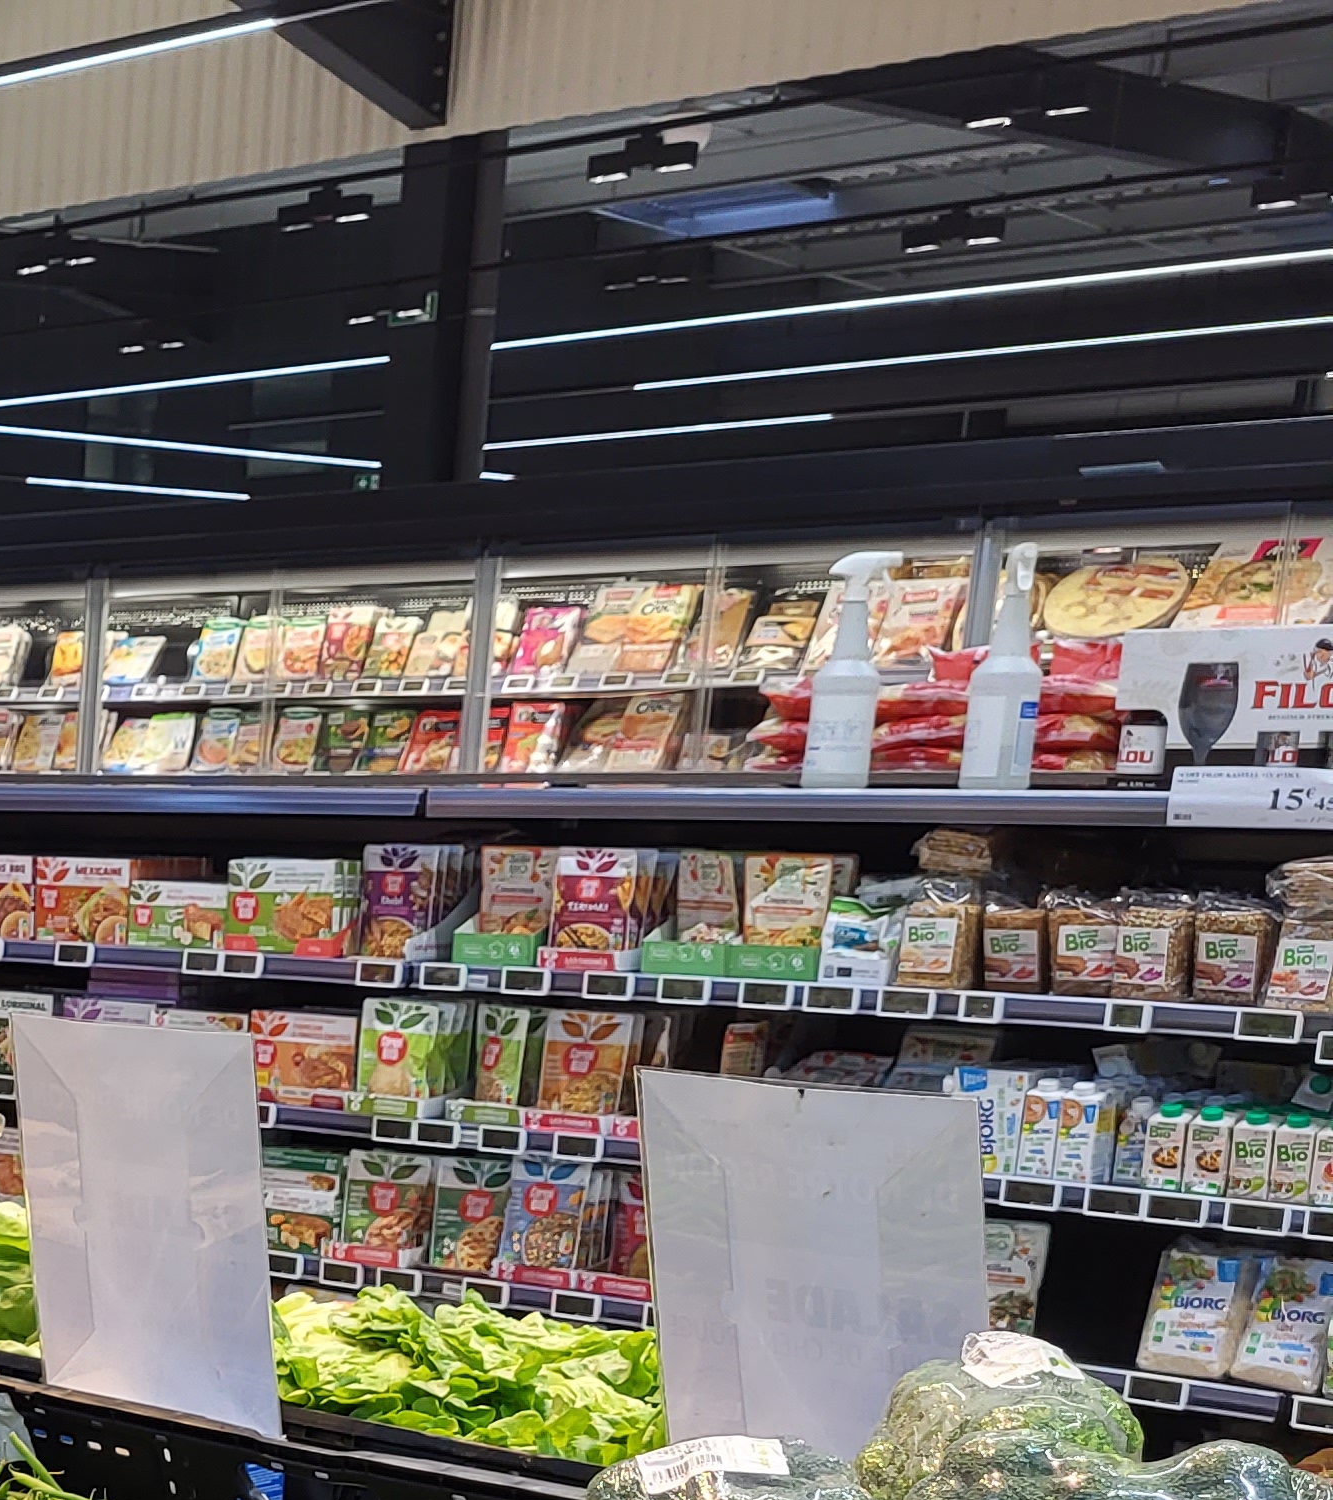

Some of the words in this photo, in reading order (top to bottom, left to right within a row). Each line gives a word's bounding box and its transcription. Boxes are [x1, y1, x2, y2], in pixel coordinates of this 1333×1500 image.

[908, 926, 935, 943] Bio
[1065, 934, 1097, 951] Bio
[989, 937, 1019, 954] Bio
[1122, 935, 1150, 953] Bio
[1205, 941, 1237, 960] Bio
[1283, 948, 1313, 967] Bio
[980, 1099, 996, 1155] BJORG
[1235, 1141, 1266, 1159] Bio
[1277, 1144, 1308, 1162] Bio
[1174, 1295, 1226, 1311] BJORG
[1271, 1308, 1326, 1325] BJORG
